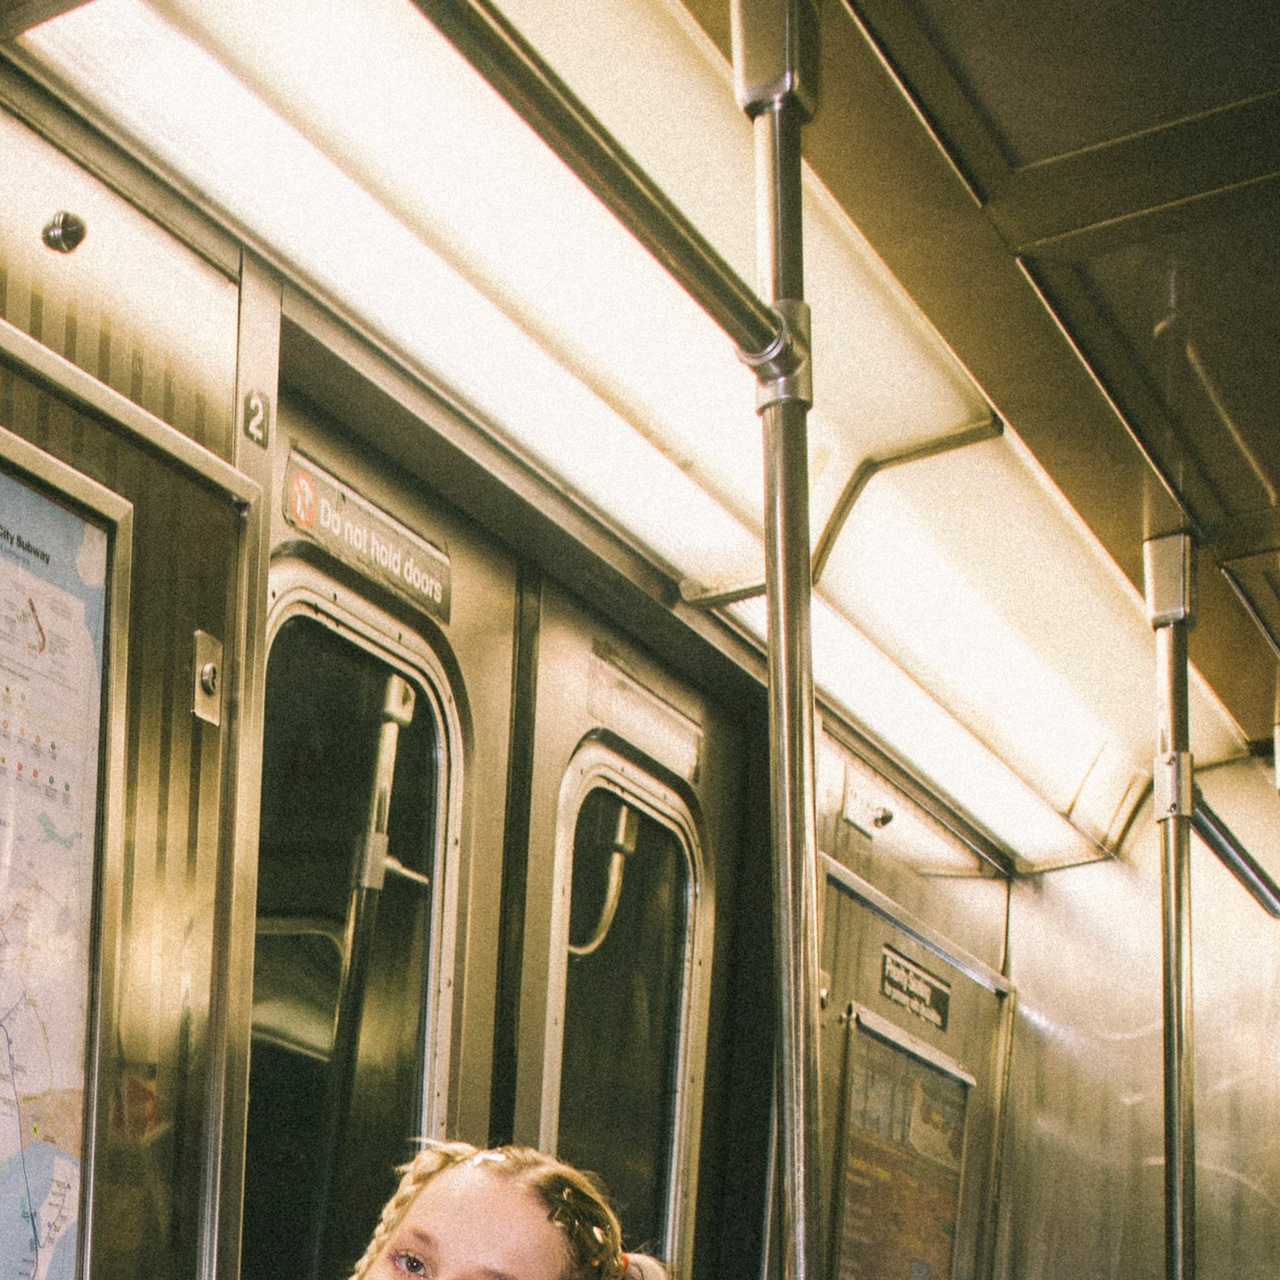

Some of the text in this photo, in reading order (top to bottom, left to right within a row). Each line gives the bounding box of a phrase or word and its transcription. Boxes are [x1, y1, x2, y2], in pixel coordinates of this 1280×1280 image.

[248, 395, 264, 441] 2
[16, 535, 51, 564] Subway
[319, 498, 443, 604] Do not hold doors
